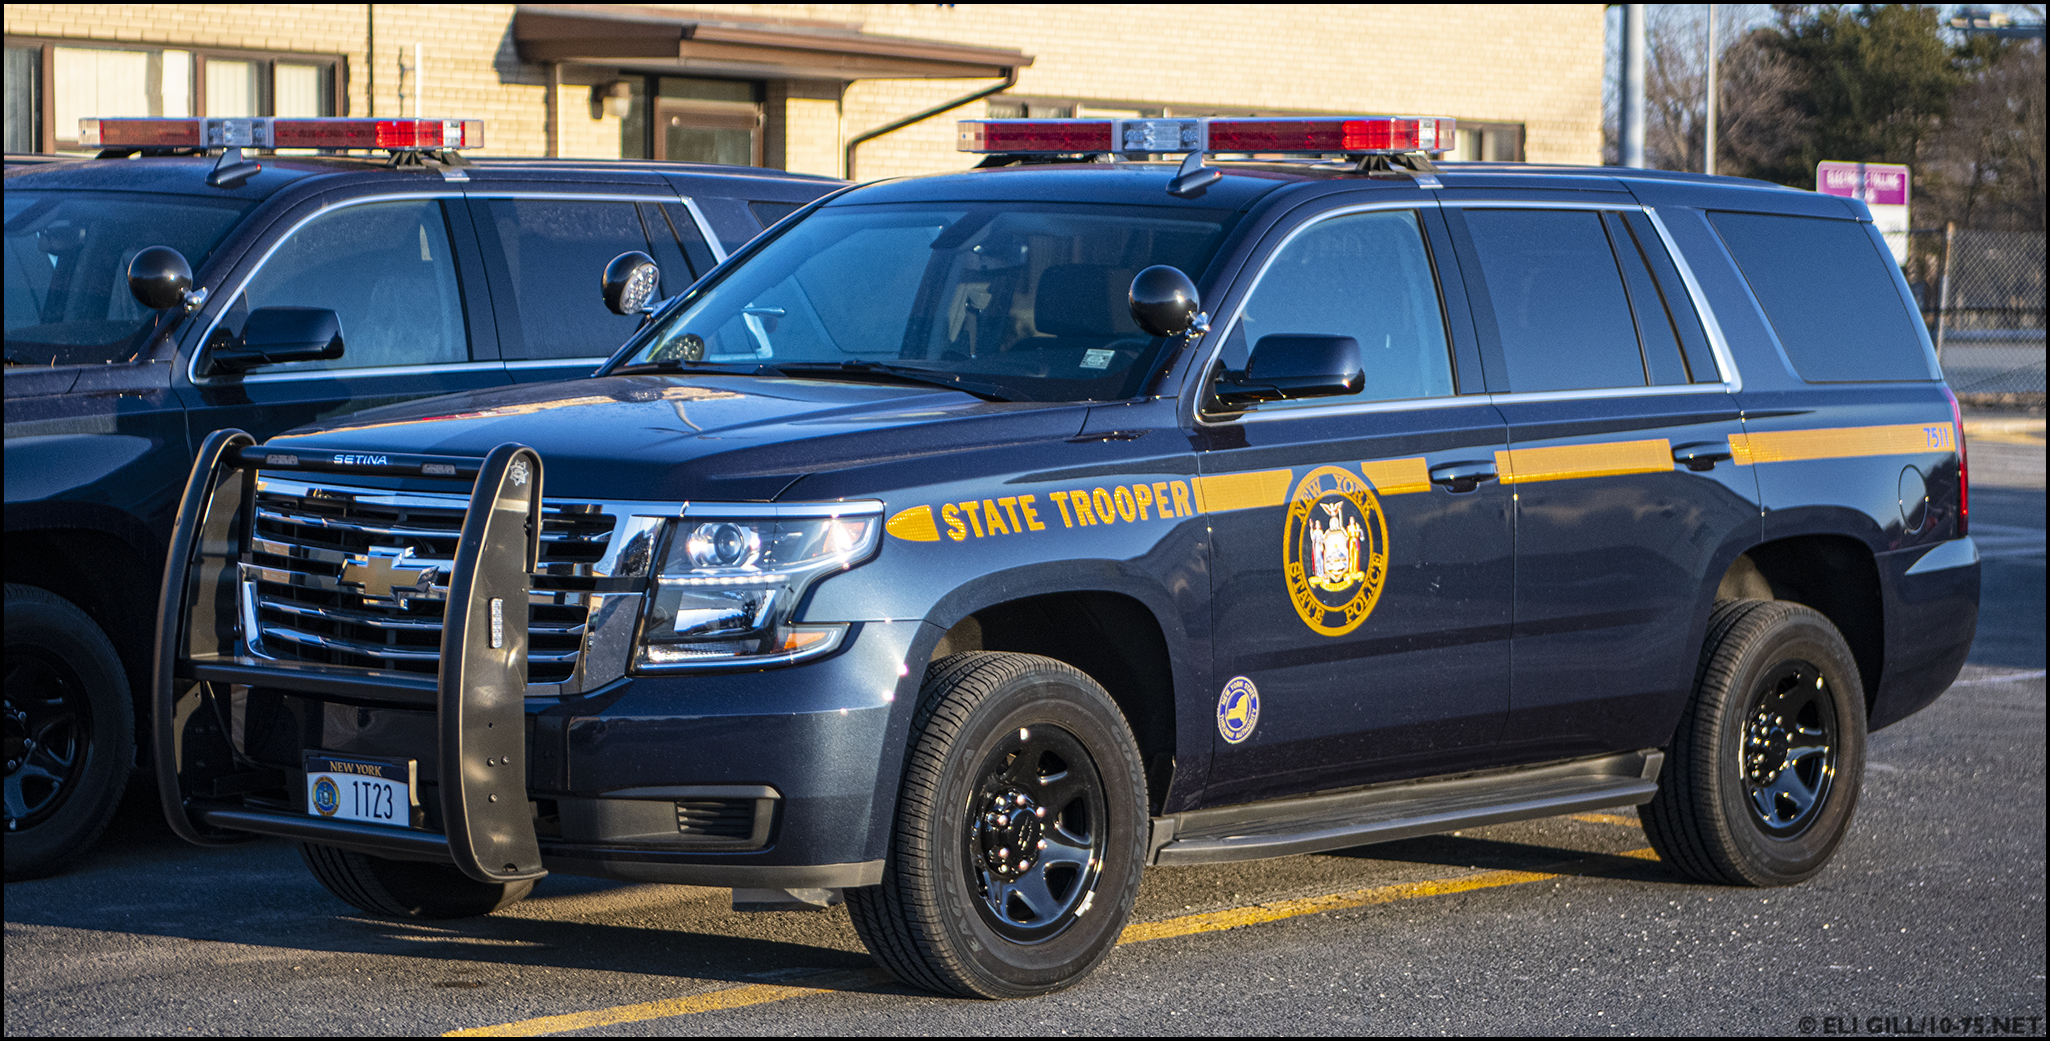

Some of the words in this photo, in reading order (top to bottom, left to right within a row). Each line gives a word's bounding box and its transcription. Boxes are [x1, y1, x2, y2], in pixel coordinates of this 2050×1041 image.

[1923, 427, 1949, 448] 7511
[333, 454, 387, 466] SETINA
[941, 494, 1046, 541] STATE
[1049, 480, 1192, 528] TROOPER
[1293, 476, 1322, 523] NEW
[1333, 473, 1375, 519] YORK
[1289, 561, 1326, 626] STATE
[1343, 552, 1383, 625] POLICE
[1221, 688, 1231, 706] NEW
[1230, 680, 1243, 690] YORK
[1243, 682, 1256, 700] STATE
[329, 760, 354, 773] NEW
[355, 763, 382, 777] YORK
[352, 780, 393, 819] 1T23
